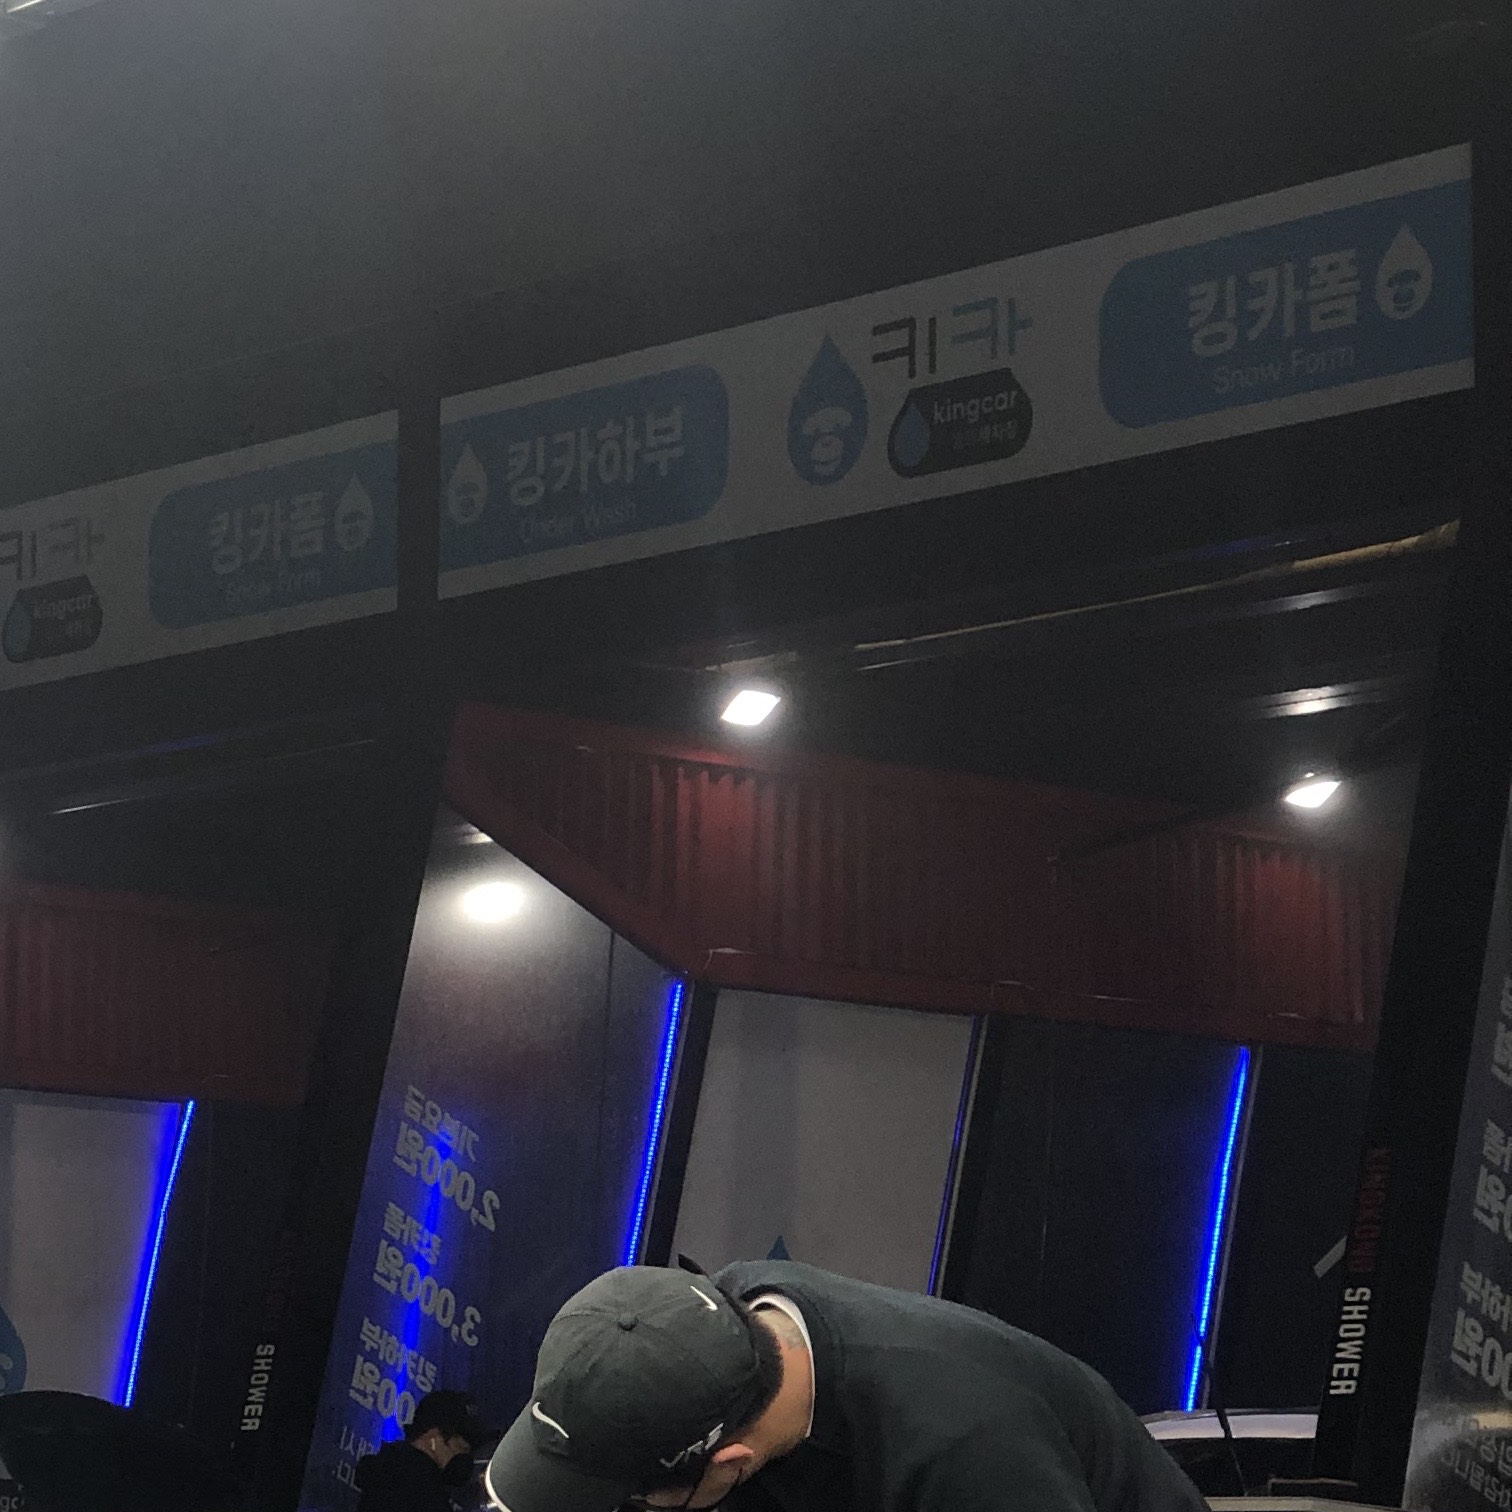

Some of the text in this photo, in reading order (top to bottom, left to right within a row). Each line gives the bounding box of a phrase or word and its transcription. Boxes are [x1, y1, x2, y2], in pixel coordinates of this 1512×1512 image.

[1188, 248, 1361, 358] 킹카폼
[933, 390, 1018, 425] kingcar
[1212, 358, 1286, 394] Snow
[506, 404, 685, 507] 킹카하부
[208, 490, 326, 574] 킹카폼
[1328, 1286, 1372, 1397] SHOWER
[240, 1343, 276, 1432] SHOWER
